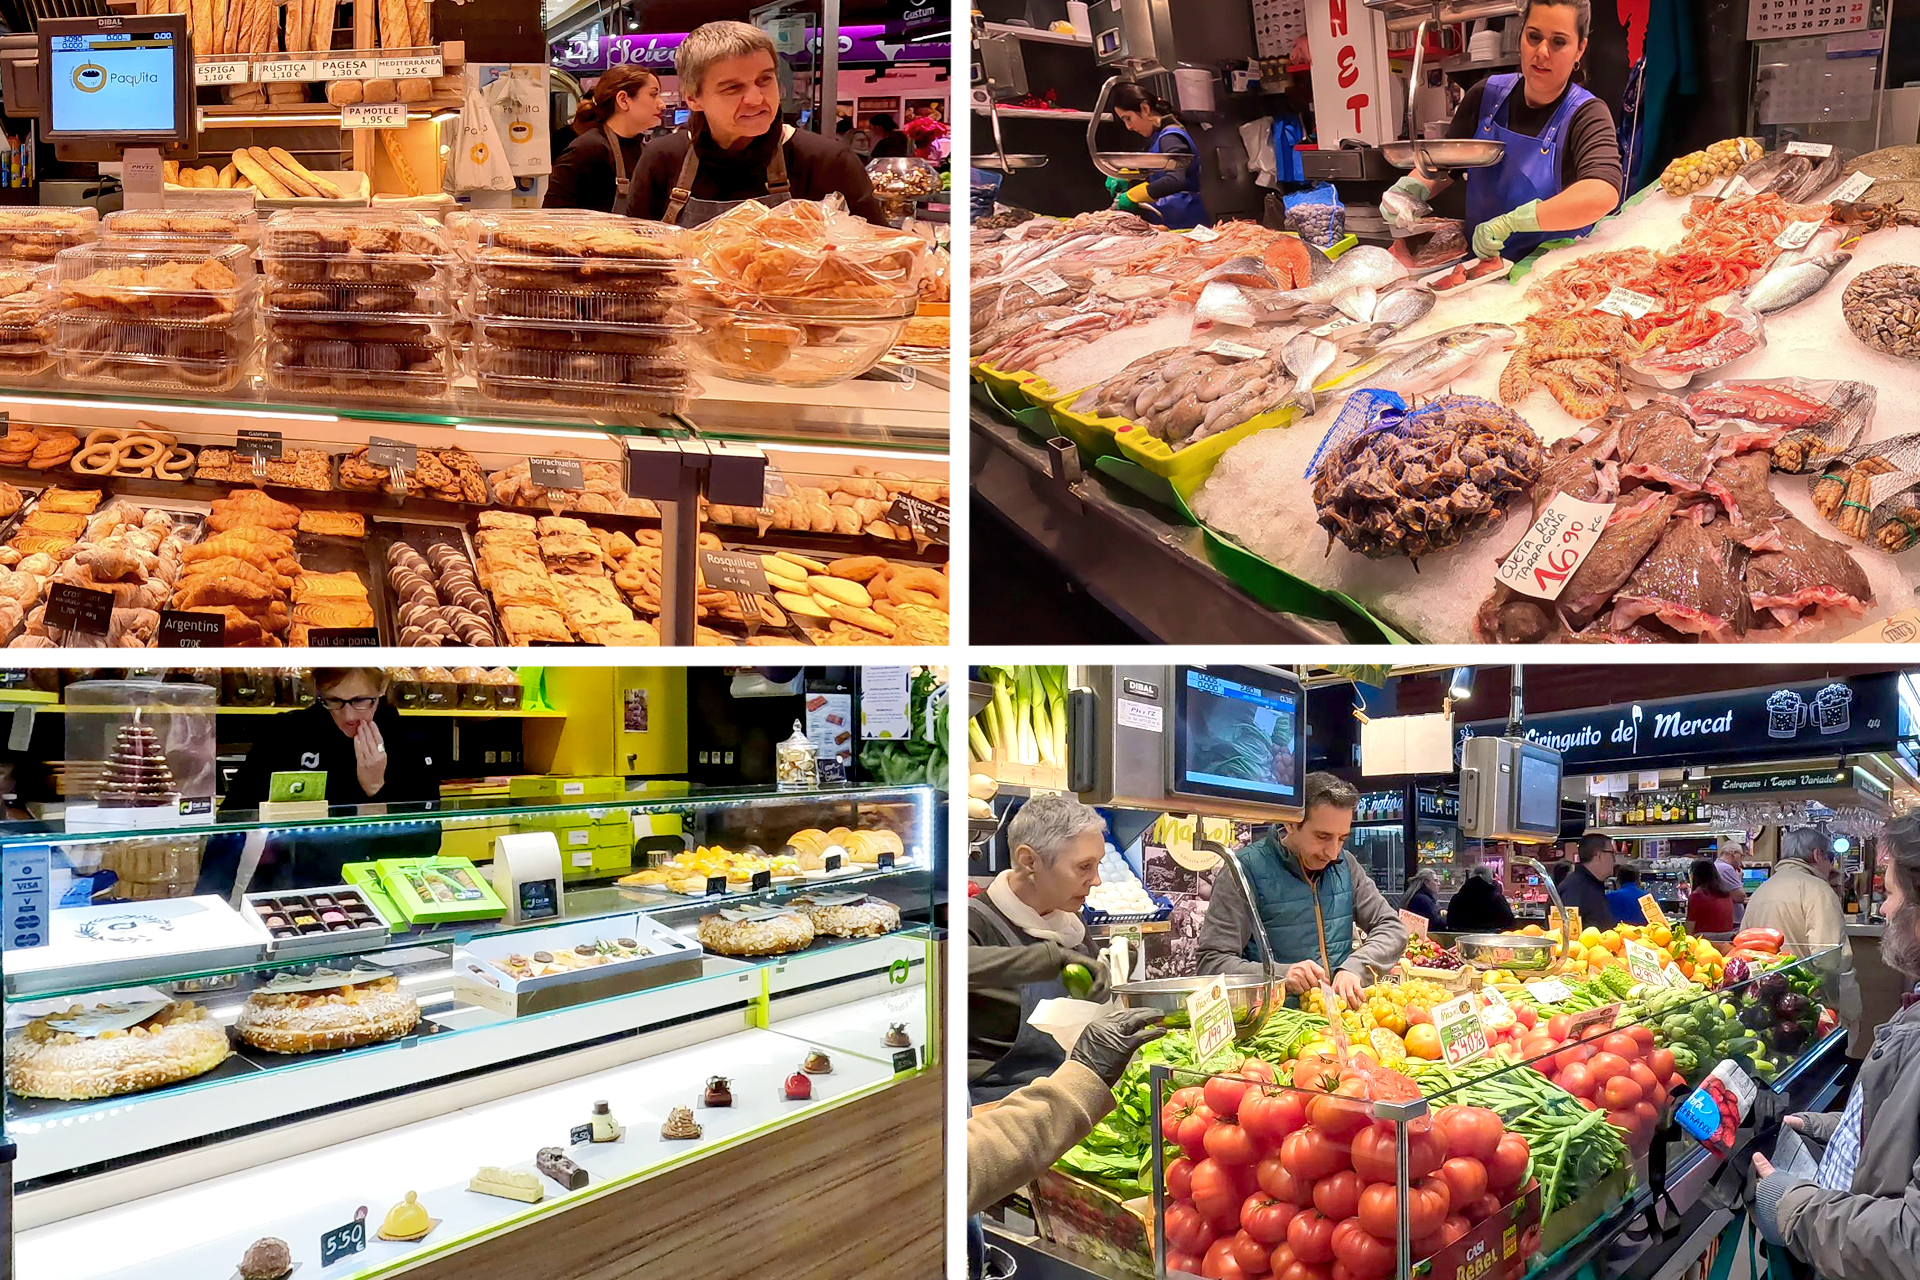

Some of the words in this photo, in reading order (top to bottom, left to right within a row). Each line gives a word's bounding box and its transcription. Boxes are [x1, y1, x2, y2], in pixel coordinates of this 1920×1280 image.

[903, 7, 935, 20] Gustum
[1819, 7, 1831, 15] 20
[1851, 3, 1863, 11] 22
[1801, 21, 1813, 29] 26
[1833, 17, 1845, 25] 28
[1850, 16, 1862, 24] 29
[606, 38, 681, 66] Selec
[262, 63, 307, 72] RÚSTICA
[322, 60, 367, 70] PAGESA
[379, 58, 441, 67] MEDITERRÀNEA
[198, 65, 236, 74] ESPIGA
[272, 71, 292, 79] 1,10
[331, 69, 352, 77] 1,30
[396, 67, 418, 76] 1,25
[110, 71, 158, 87] Paquita
[204, 73, 224, 82] 1,10
[349, 107, 361, 115] PA
[364, 107, 399, 115] MOTLLE
[503, 104, 540, 114] Paita
[361, 116, 383, 125] 1,95
[530, 457, 580, 469] borrachuelos
[1535, 508, 1555, 535] RAP
[1515, 513, 1568, 581] TARRAGONA
[706, 553, 758, 569] Rosquilles
[165, 618, 219, 633] Argentins
[311, 637, 330, 646] Full
[348, 637, 377, 648] poma
[1129, 681, 1154, 694] DIBAL
[1654, 709, 1734, 739] Mercat
[1867, 718, 1881, 729] 44
[1722, 779, 1761, 791] Entrepans
[1770, 776, 1797, 788] Tapes
[1800, 774, 1838, 785] Variades
[1153, 812, 1237, 847] Maoli
[17, 881, 38, 890] VISA
[1466, 1240, 1485, 1262] CASI
